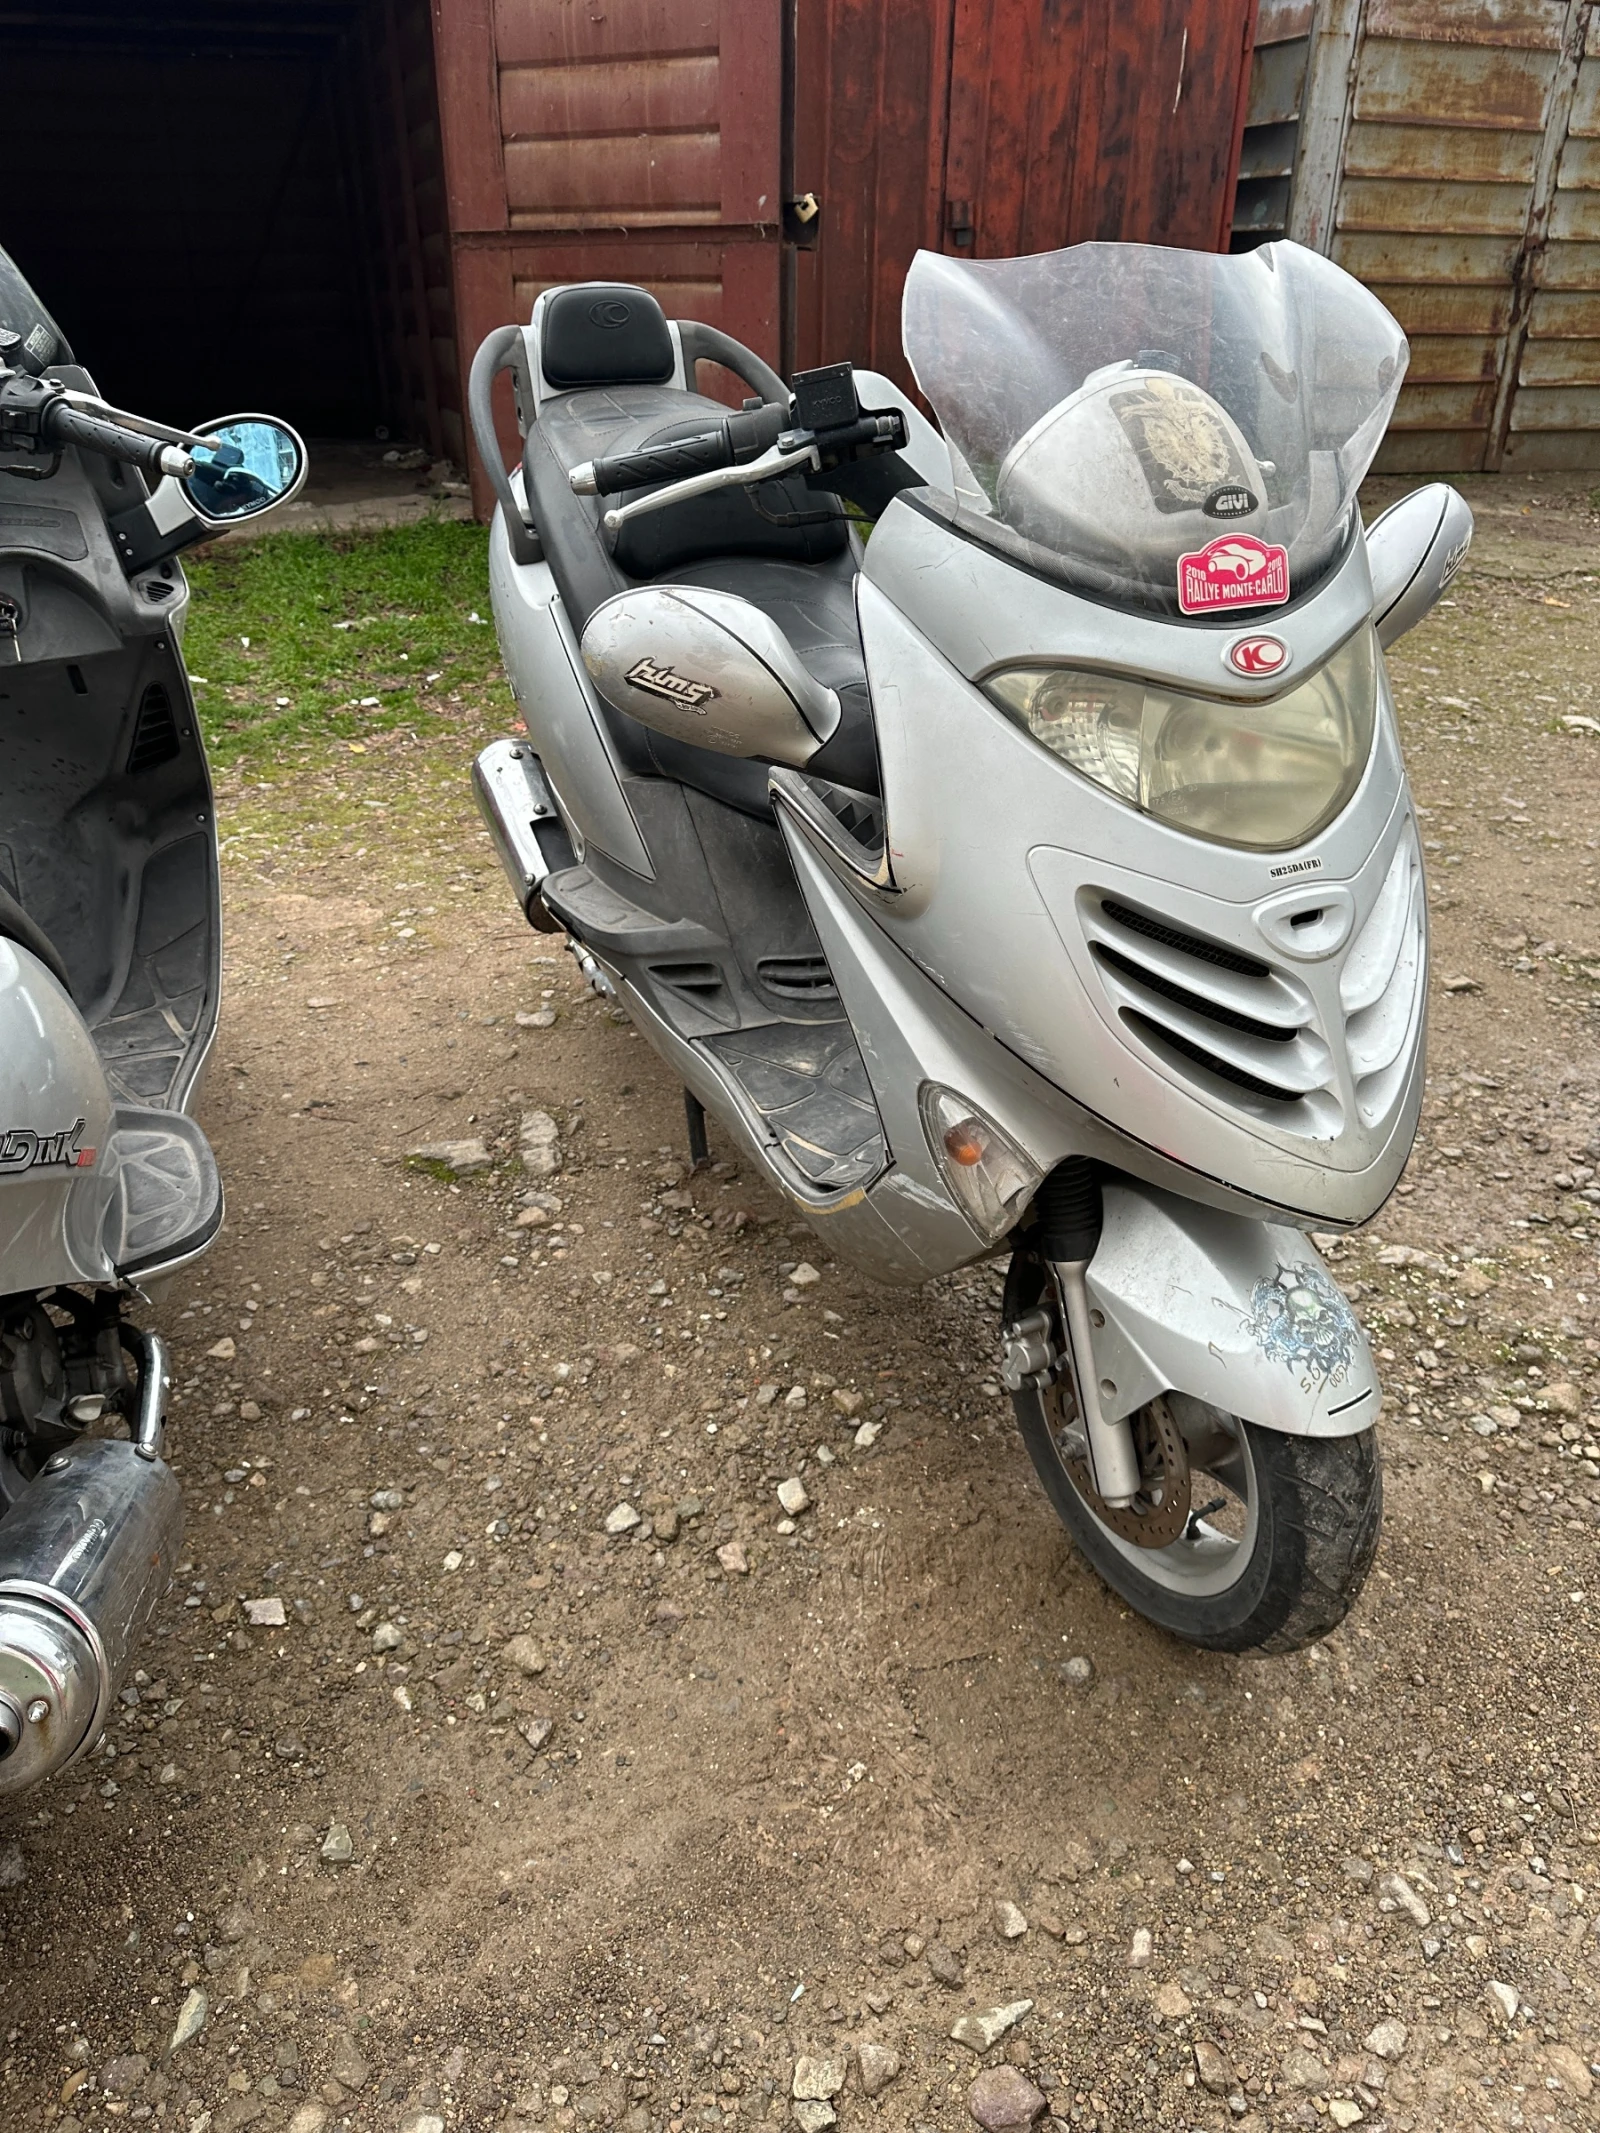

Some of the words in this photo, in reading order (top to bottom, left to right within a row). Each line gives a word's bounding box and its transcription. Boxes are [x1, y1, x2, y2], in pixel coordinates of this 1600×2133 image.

[1215, 493, 1249, 510] GIVI
[1186, 564, 1206, 581] 2010
[1267, 555, 1283, 574] 2010
[1186, 575, 1220, 603] RALLYE
[1222, 566, 1284, 599] MONTE-CARLO
[1270, 858, 1322, 878] SH25DA(FR)
